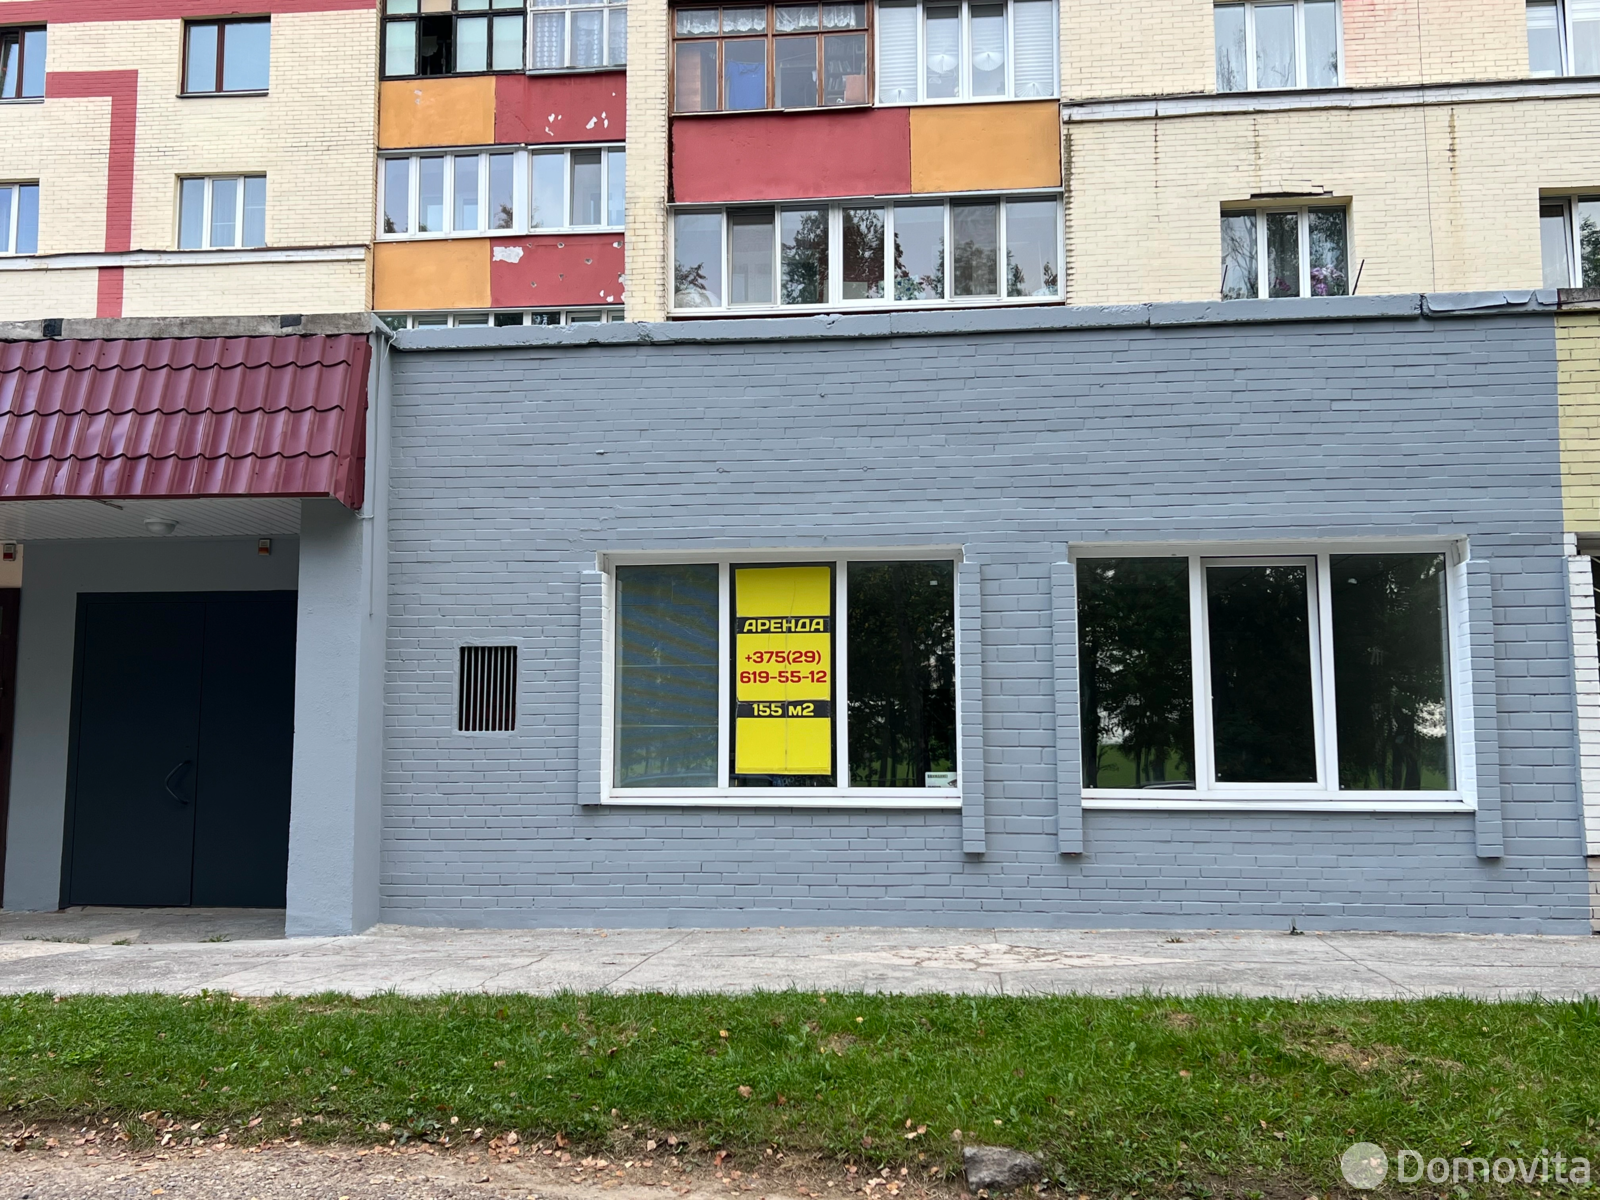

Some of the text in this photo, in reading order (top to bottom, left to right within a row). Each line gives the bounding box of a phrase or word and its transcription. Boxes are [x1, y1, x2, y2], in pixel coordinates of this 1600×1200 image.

[743, 619, 824, 632] АРЕНДА
[745, 650, 822, 665] +375(29)
[740, 671, 827, 684] 619-55-12
[752, 703, 783, 716] 155
